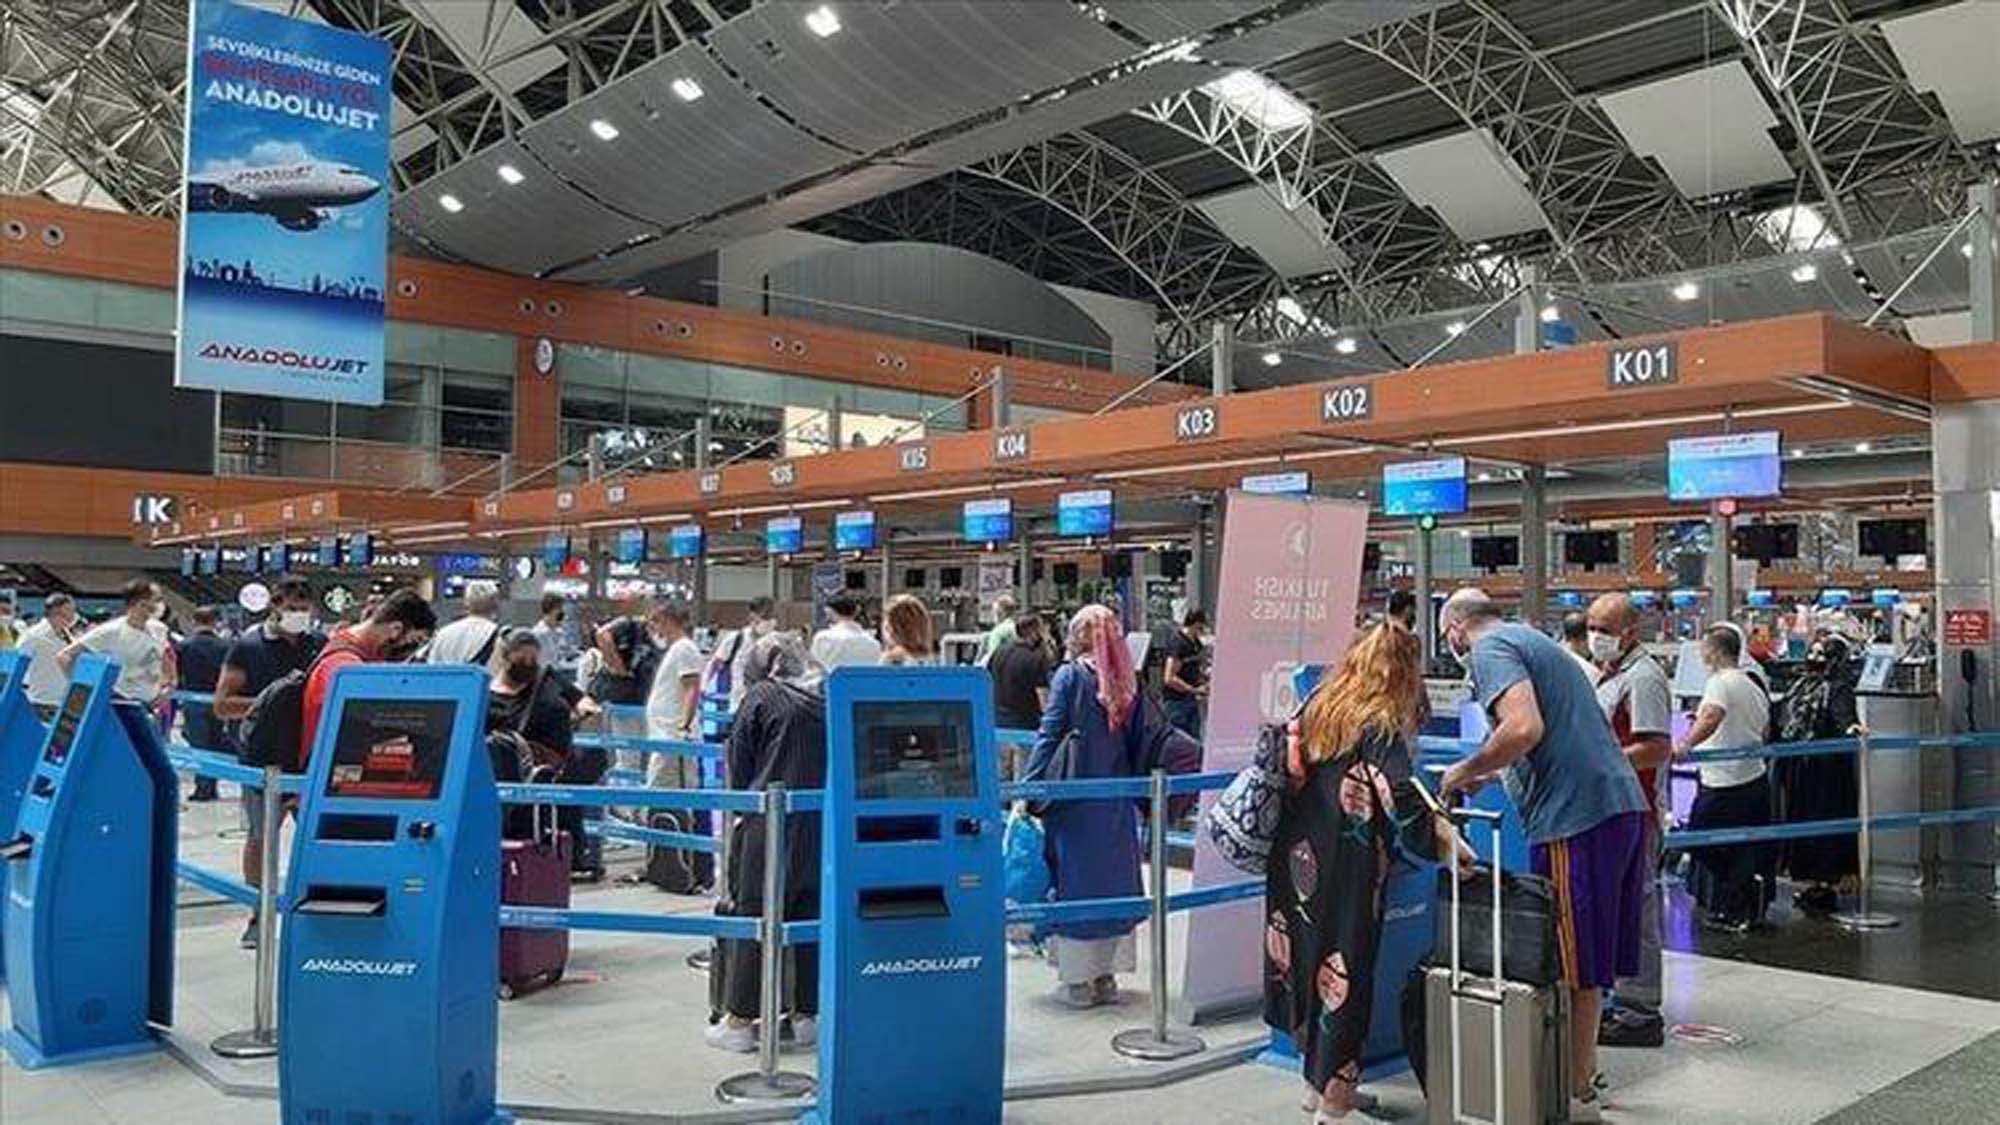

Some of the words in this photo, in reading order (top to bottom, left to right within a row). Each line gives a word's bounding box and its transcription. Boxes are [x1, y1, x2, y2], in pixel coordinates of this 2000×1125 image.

[205, 79, 380, 131] ANADOLUJET
[199, 342, 369, 375] ANADOLUJET
[1614, 346, 1669, 383] K01
[1324, 387, 1367, 420] K02
[1178, 408, 1215, 437] K03
[997, 433, 1025, 457] K04
[301, 958, 417, 976] ANADOLUJET
[861, 955, 983, 975] ANADOLUJET
